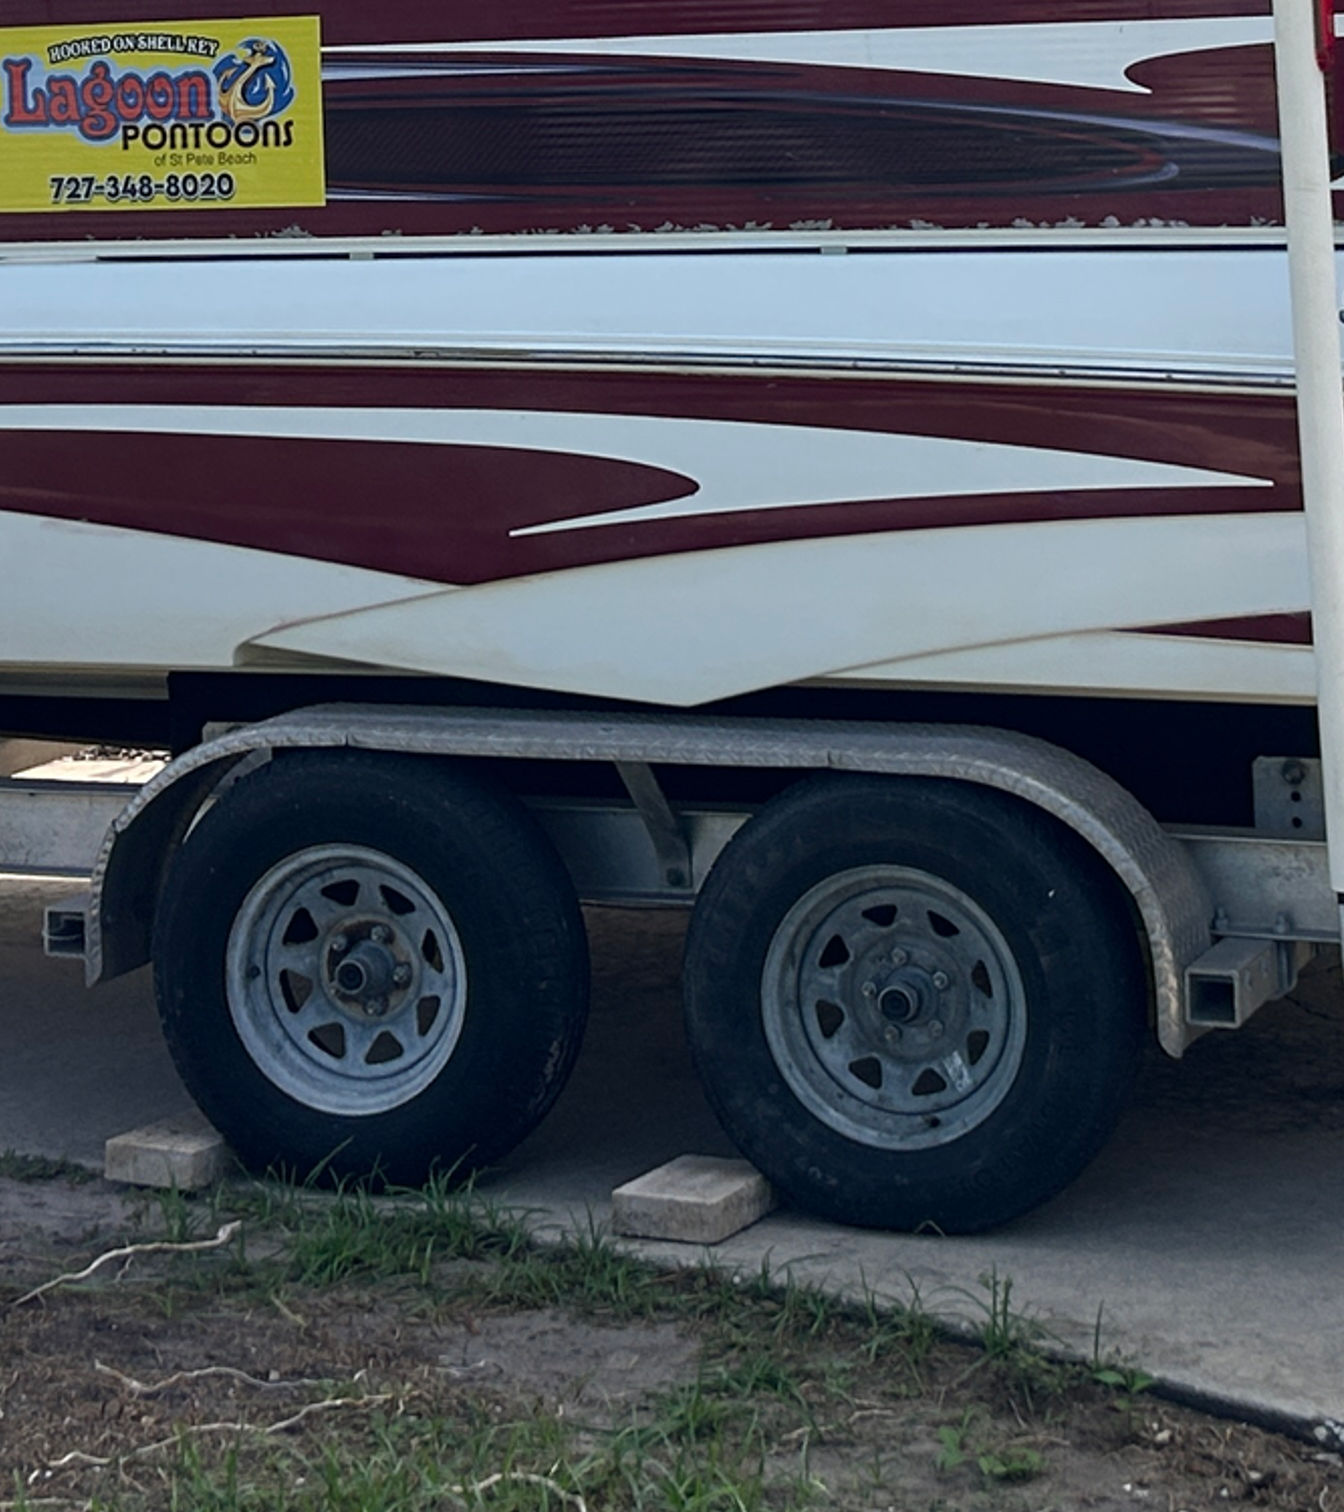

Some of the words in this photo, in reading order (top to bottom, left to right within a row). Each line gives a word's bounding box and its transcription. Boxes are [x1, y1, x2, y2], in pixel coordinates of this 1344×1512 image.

[48, 35, 112, 64] HOOKED
[112, 34, 136, 54] ON
[136, 33, 185, 53] SHELL
[185, 35, 219, 58] KEY
[2, 57, 215, 139] Lagoon
[154, 153, 167, 168] of
[169, 152, 183, 166] St
[186, 152, 215, 166] Pete
[217, 151, 257, 165] Beach
[49, 173, 236, 202] 727-348-8020
